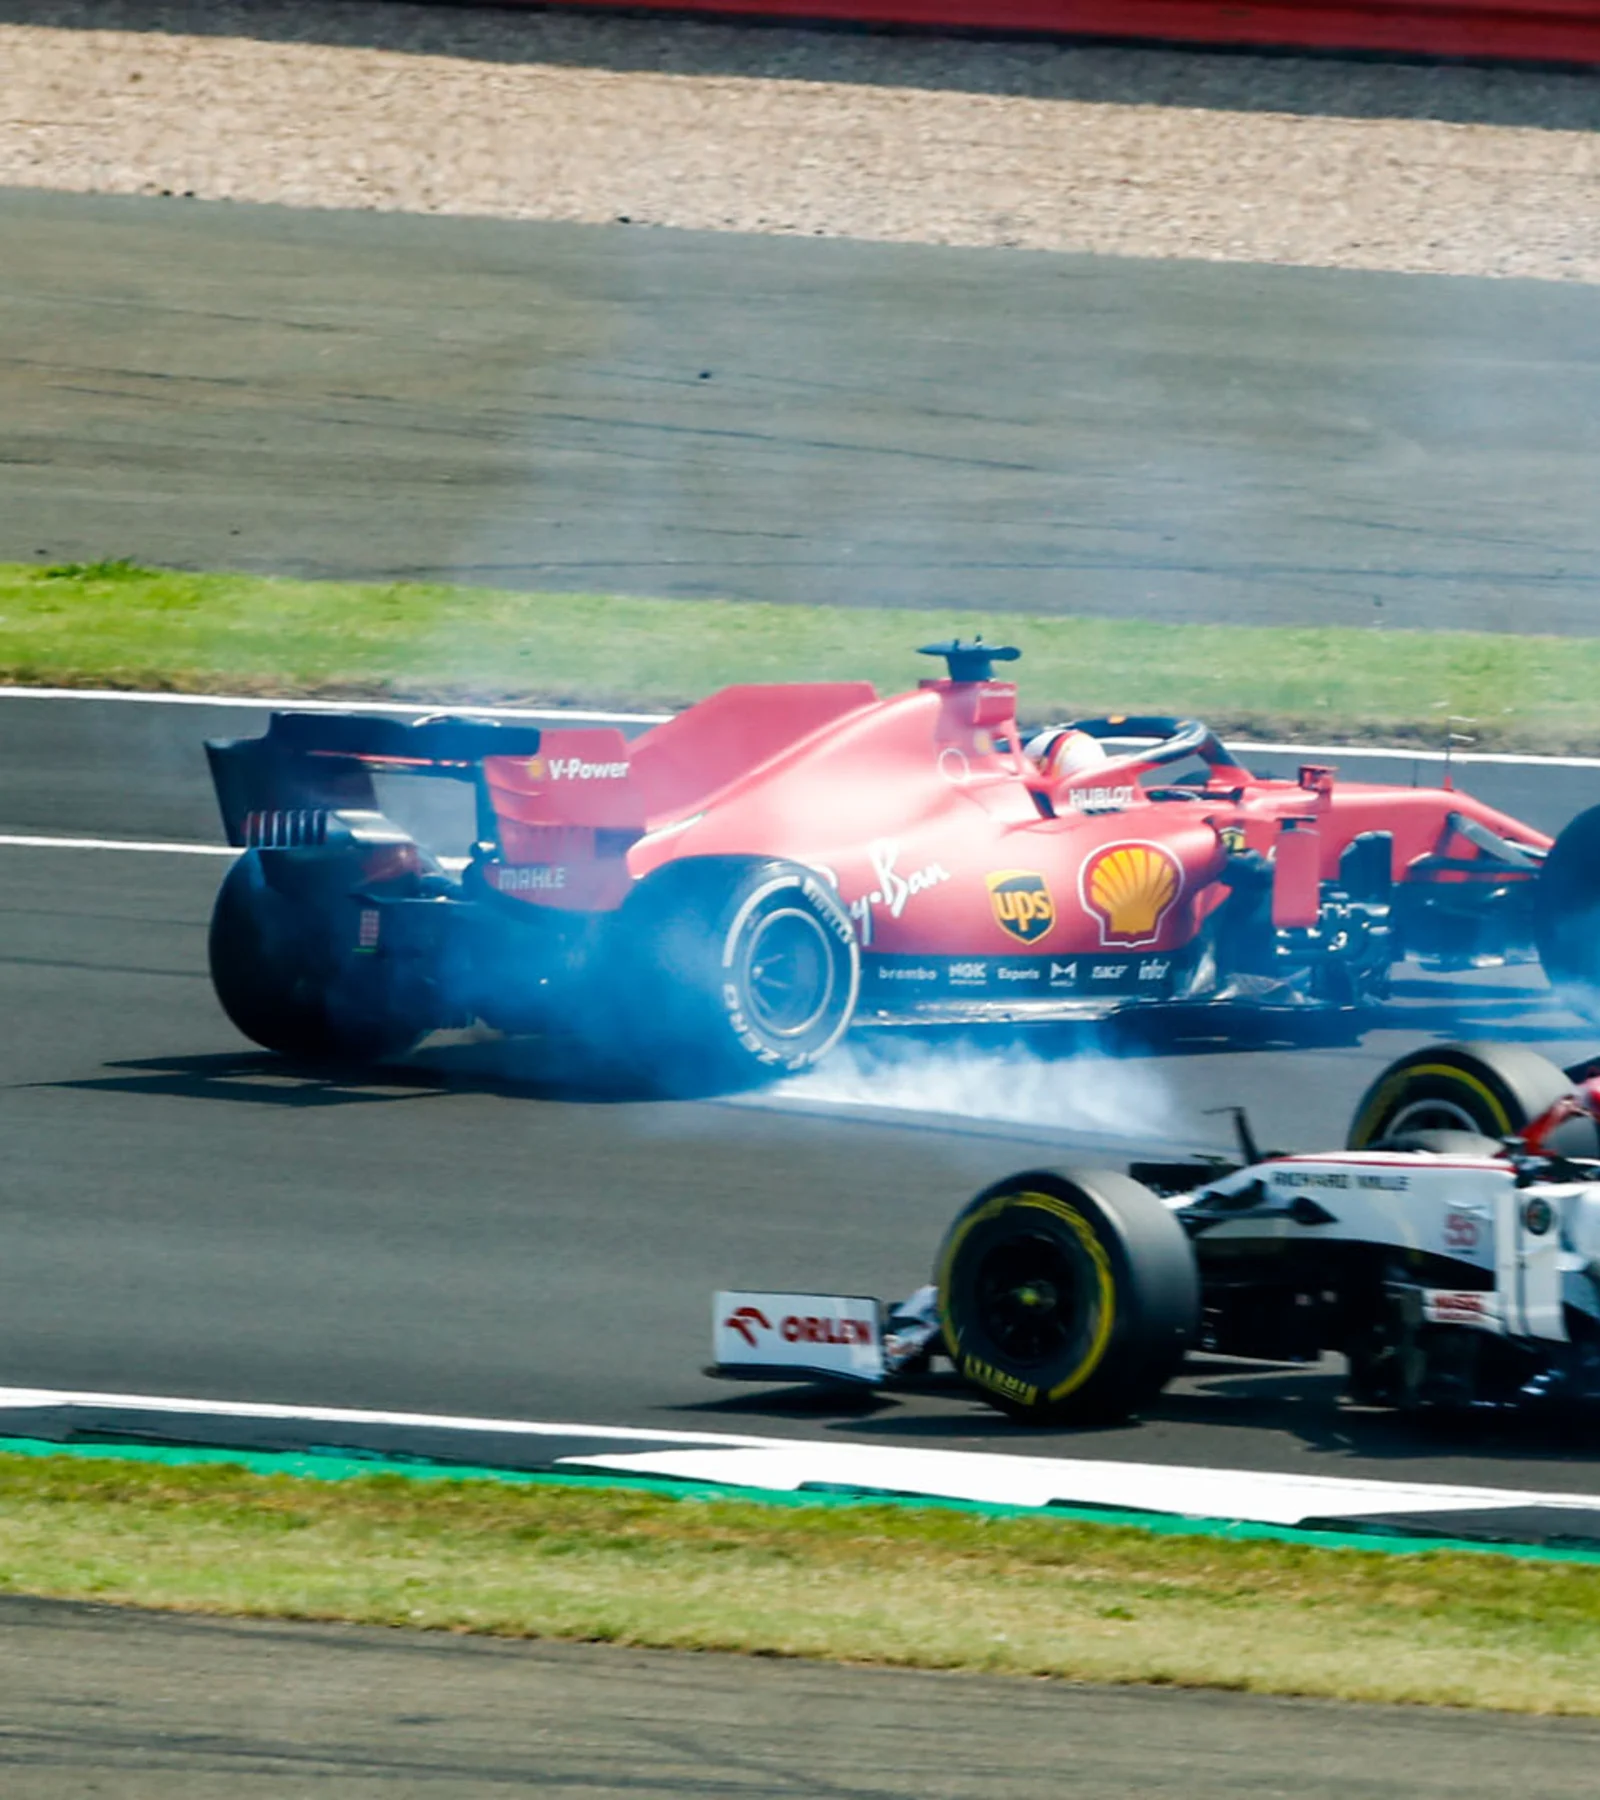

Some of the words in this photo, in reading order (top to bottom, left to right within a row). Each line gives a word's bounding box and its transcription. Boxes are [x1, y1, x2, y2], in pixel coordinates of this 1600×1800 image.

[548, 758, 631, 781] V-Power
[1068, 786, 1134, 809] HUBLOT
[498, 867, 567, 891] MAHLE
[990, 889, 1053, 932] ups
[780, 1315, 871, 1345] ORLEN
